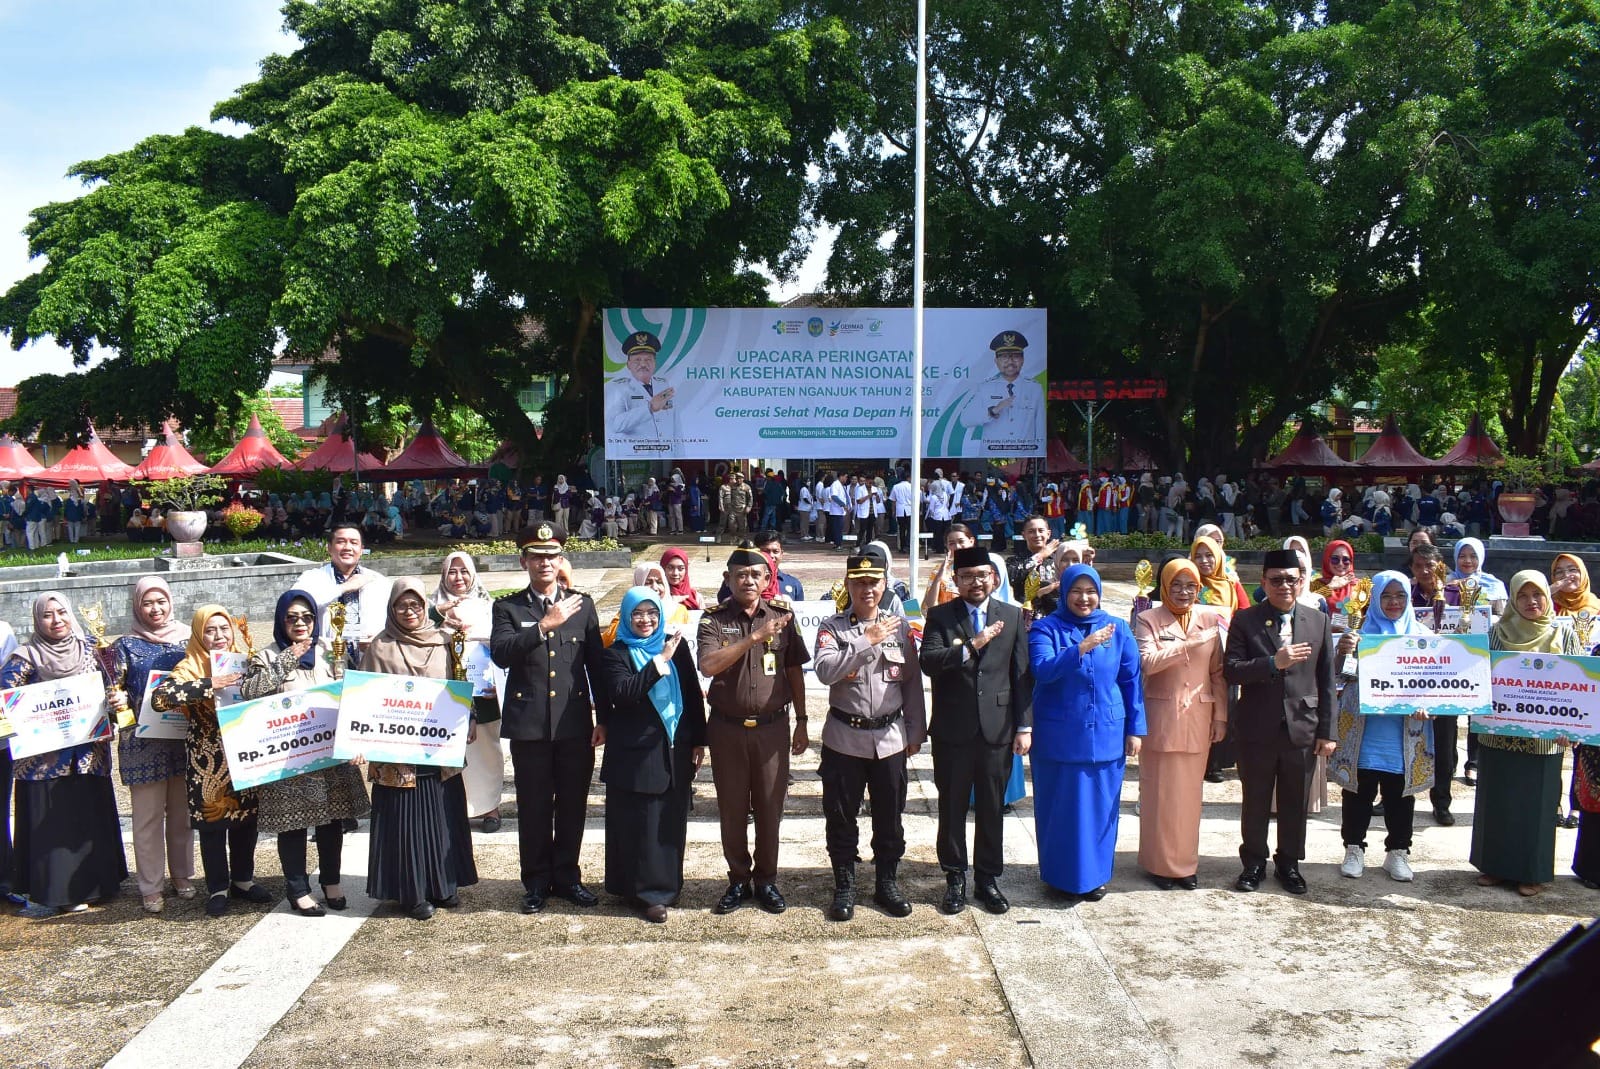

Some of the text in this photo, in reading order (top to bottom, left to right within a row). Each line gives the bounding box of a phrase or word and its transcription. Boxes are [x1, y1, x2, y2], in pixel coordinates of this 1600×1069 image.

[737, 350, 814, 362] UPACARA
[686, 366, 725, 379] HARI
[730, 366, 827, 379] KESEHATAN
[831, 366, 914, 379] NASIONAL
[953, 366, 970, 379] 61
[723, 386, 933, 397] KABUPATEN NGANJUK TAHUN 225
[714, 406, 770, 418] Generasi
[773, 406, 809, 418] Sehat
[814, 406, 849, 418] Masa
[853, 406, 896, 421] Depan
[762, 428, 796, 436] Alun-Alun
[829, 428, 836, 436] 12
[838, 428, 874, 436] November
[876, 428, 894, 436] 2025
[1396, 655, 1451, 665] JUARA III
[1370, 679, 1480, 691] Rp. 1.000.000,-
[1491, 677, 1596, 693] UARA HARAPAN I
[32, 695, 81, 713] JUARA I
[382, 698, 433, 711] JUARA II
[1516, 702, 1589, 721] 800.000,-
[266, 710, 316, 729] JUARA I
[350, 720, 457, 741] Rp. 1.500.000,-
[238, 750, 264, 762] Rp.
